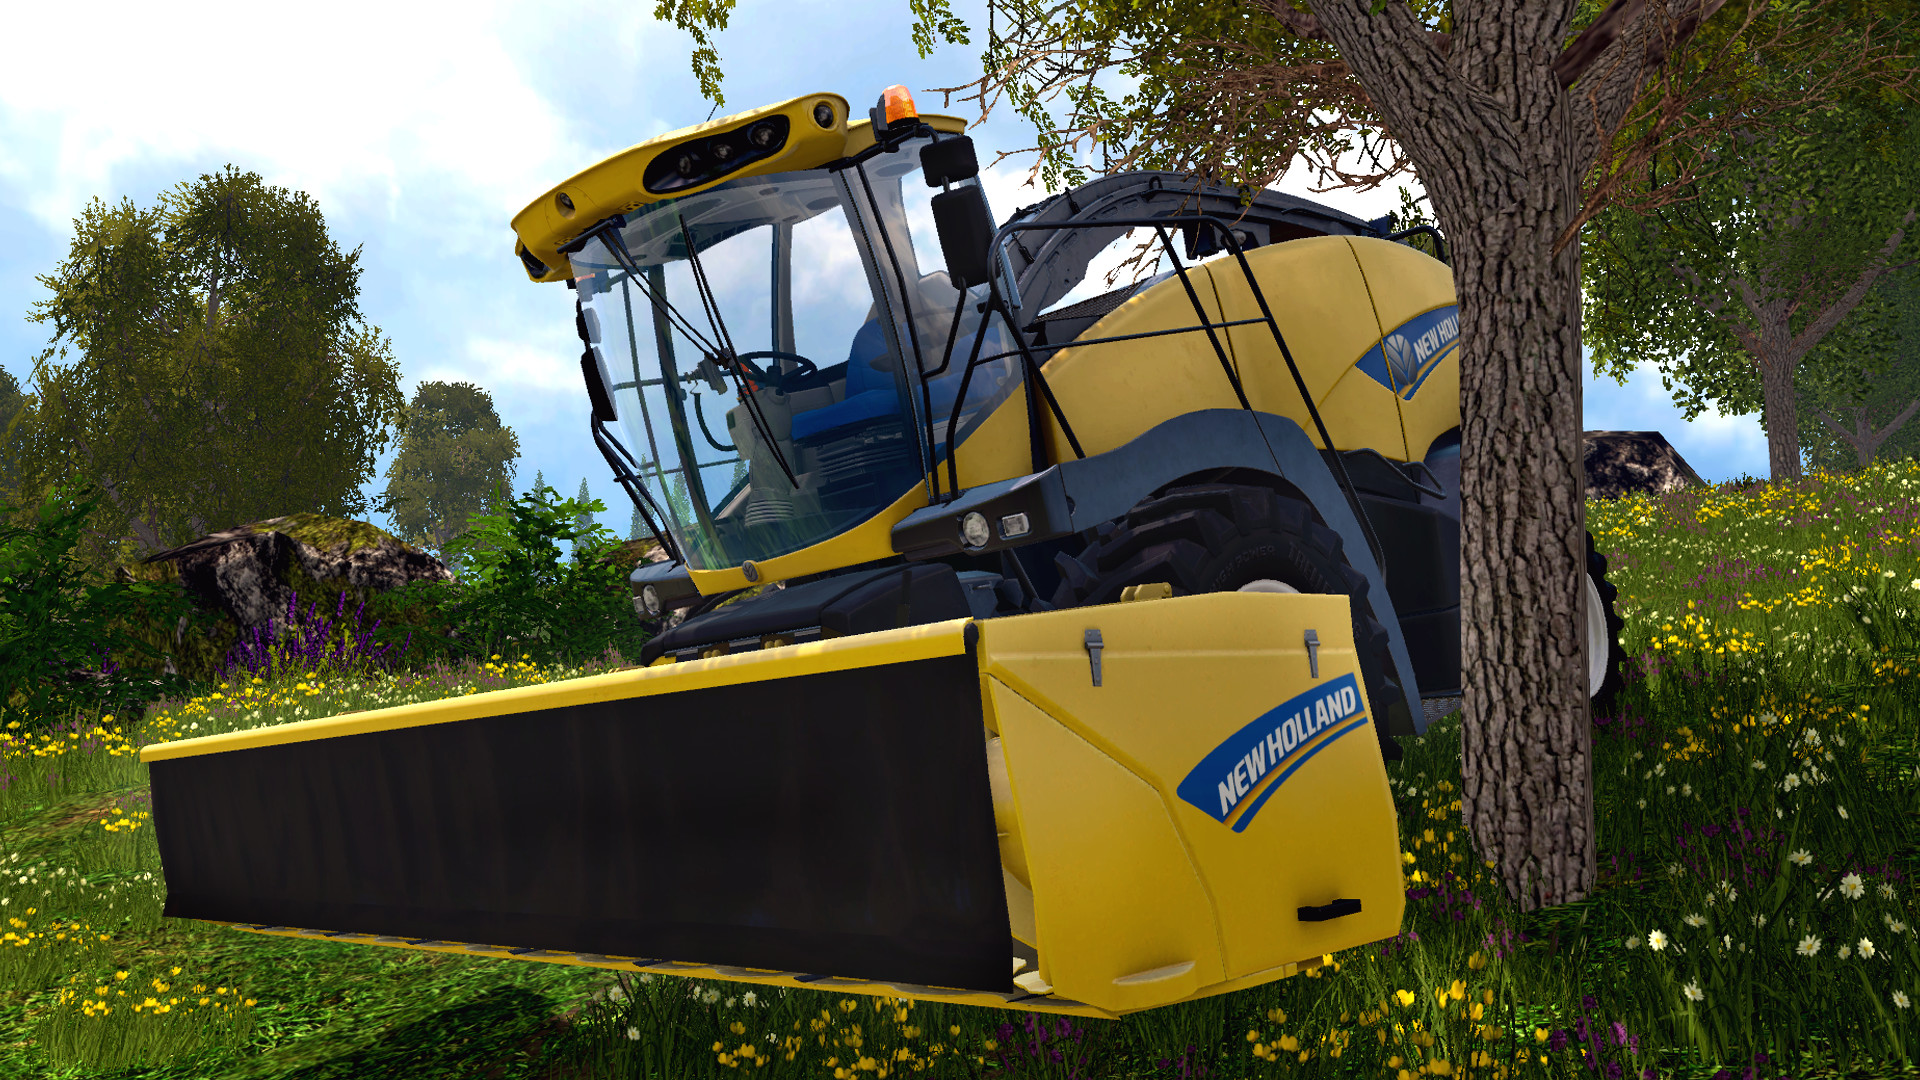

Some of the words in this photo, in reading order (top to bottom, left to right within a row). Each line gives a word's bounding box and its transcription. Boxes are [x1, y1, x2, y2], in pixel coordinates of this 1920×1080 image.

[1413, 326, 1440, 364] NEW
[1436, 313, 1459, 344] HOLL
[1234, 545, 1276, 568] POWER
[1217, 740, 1267, 817] NEW
[1266, 685, 1357, 767] HOLLAND
